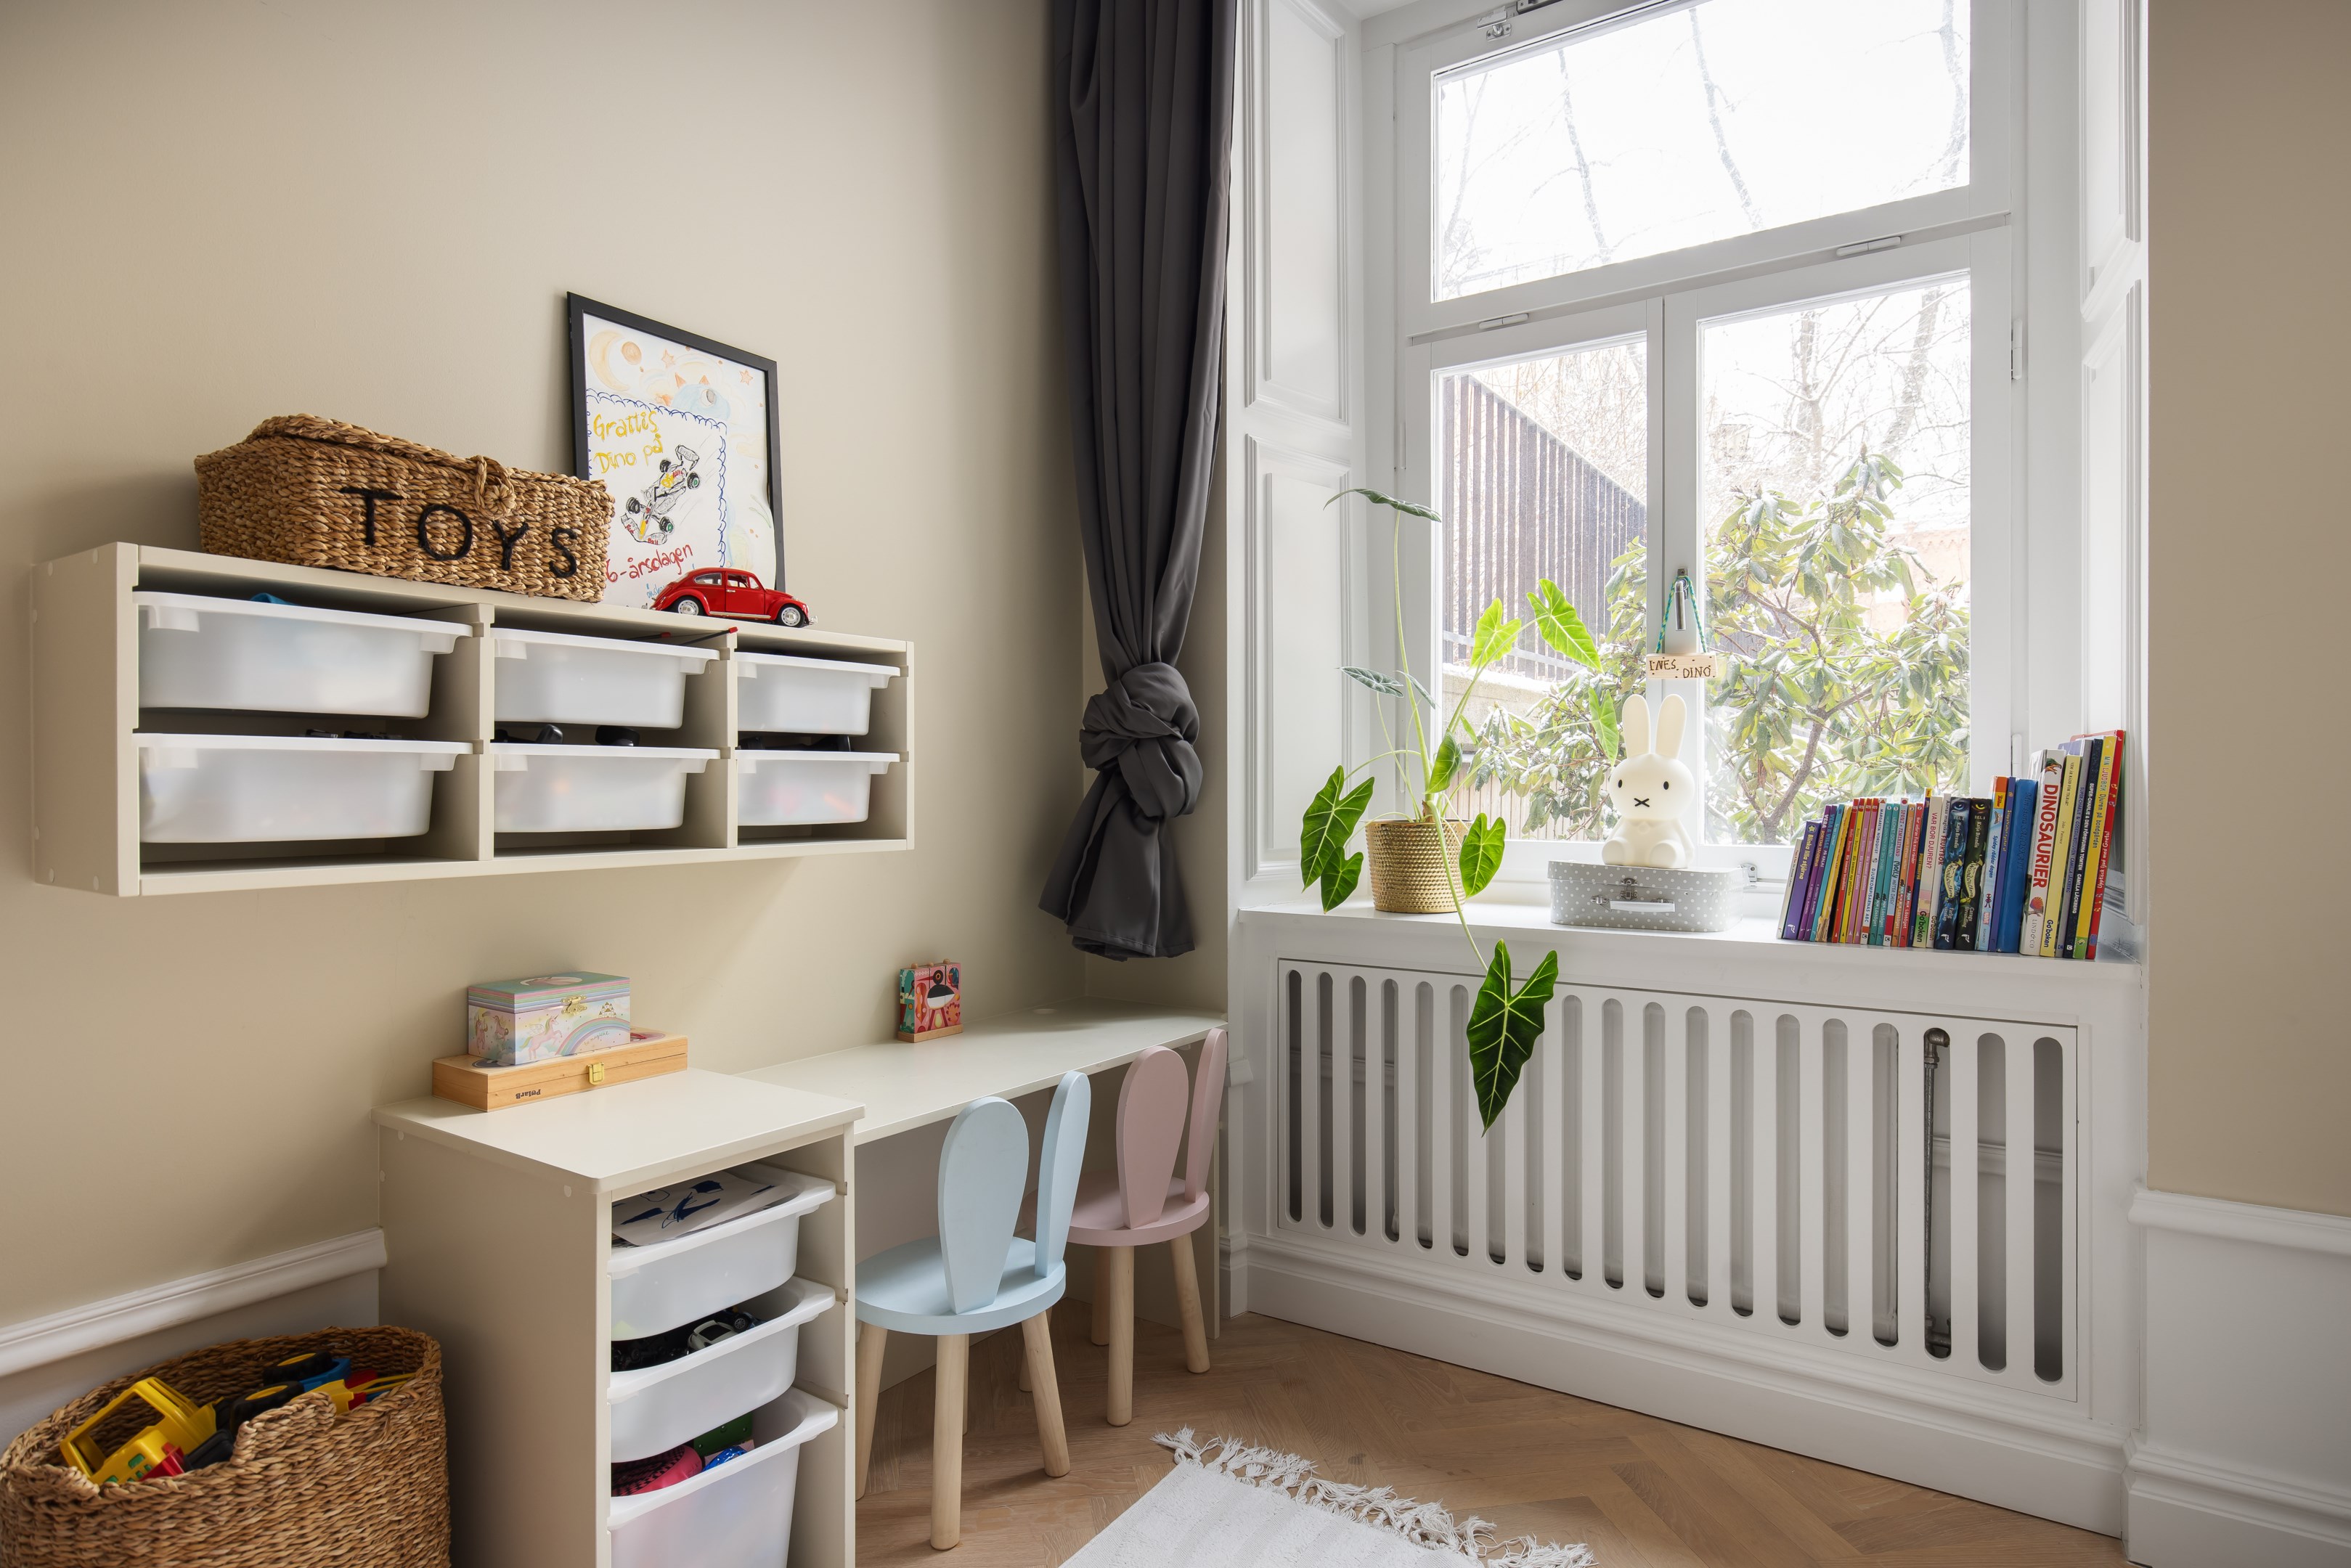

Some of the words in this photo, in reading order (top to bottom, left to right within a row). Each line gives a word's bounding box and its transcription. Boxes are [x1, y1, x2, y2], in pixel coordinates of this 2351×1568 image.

[593, 410, 659, 441] Grattis
[593, 451, 637, 474] Dino
[643, 433, 664, 466] på
[340, 486, 578, 578] TOYS
[606, 544, 693, 583] 6-årsdagen
[1649, 659, 1676, 671] INES
[1682, 666, 1711, 678] DINO
[2100, 767, 2108, 791] LJUDBOK
[2085, 782, 2095, 815] SUPER-CHARLIE
[2097, 793, 2106, 811] Djuren
[1805, 833, 1814, 849] Blinka
[2032, 783, 2058, 889] DINOSAURIER
[2090, 819, 2101, 849] bondgården
[1926, 840, 1934, 869] DJUREN?
[1937, 835, 1947, 865] FRUKTBOK
[1798, 859, 1808, 879] stjärna
[1891, 860, 1900, 878] Molly
[1865, 867, 1875, 912] DJURKOMPISARNAS
[2043, 918, 2053, 947] Go'boken
